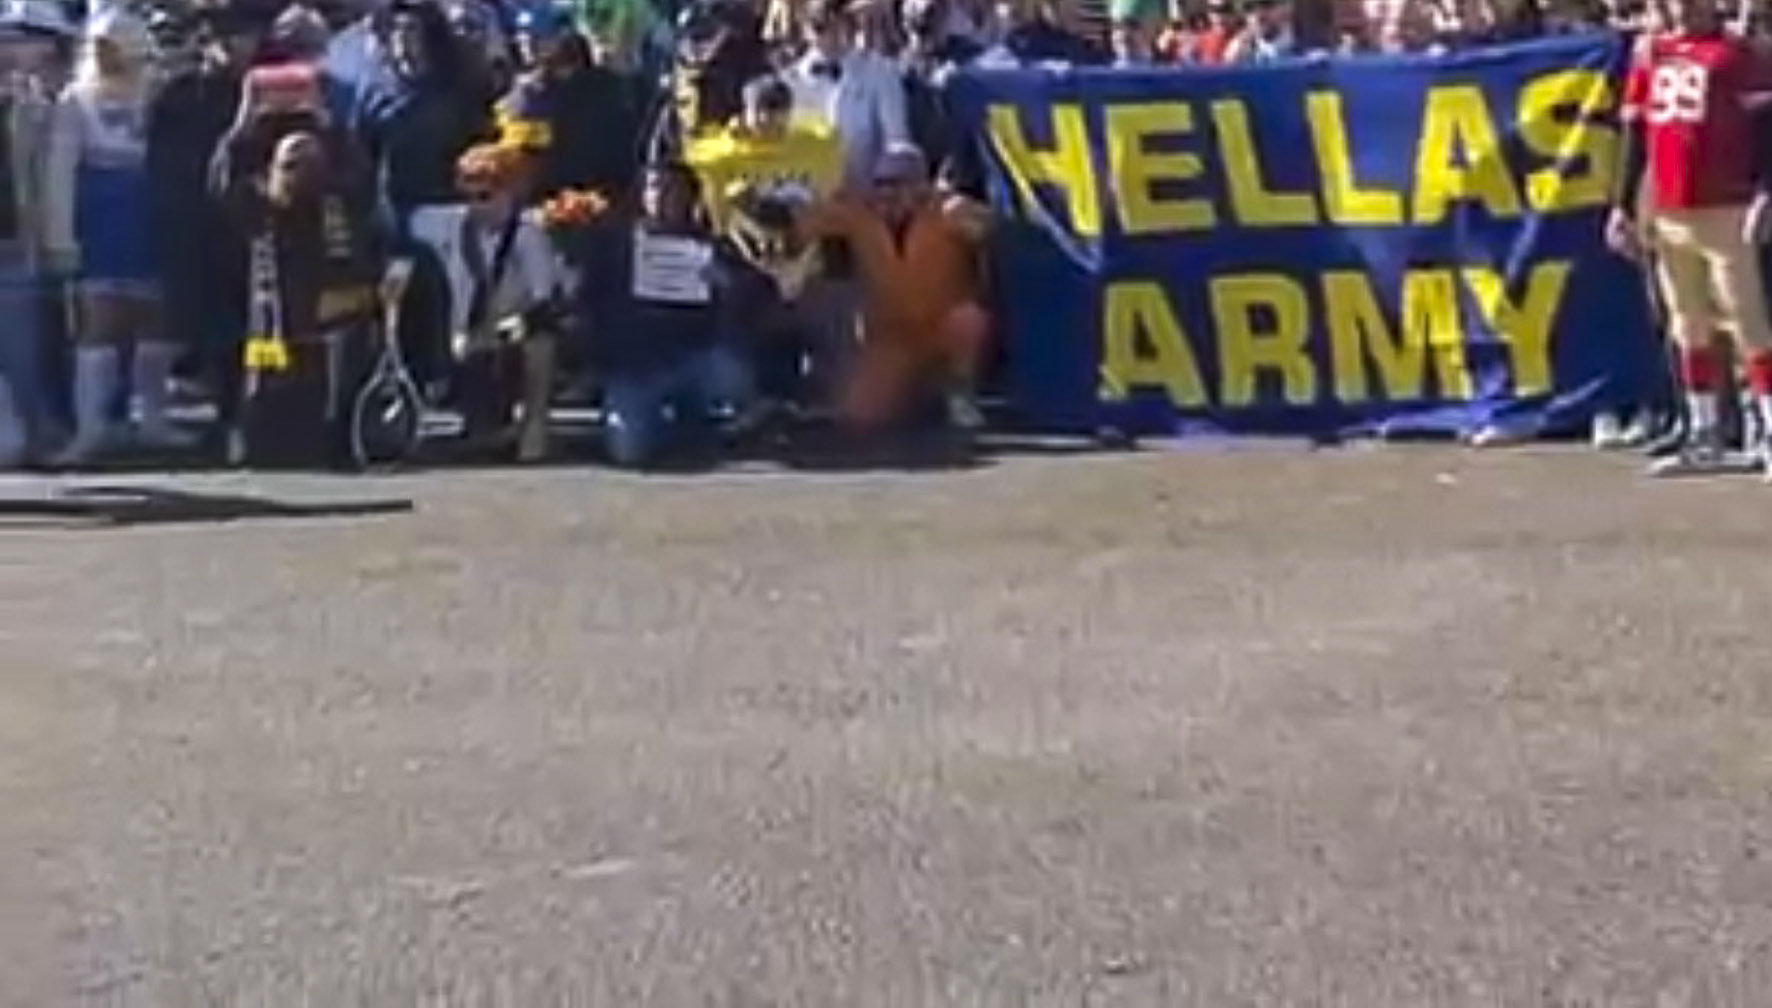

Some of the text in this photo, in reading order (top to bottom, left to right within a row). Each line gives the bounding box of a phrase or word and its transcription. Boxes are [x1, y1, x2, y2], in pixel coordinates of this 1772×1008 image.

[985, 68, 1620, 236] HELLAS
[1648, 64, 1708, 123] 99
[1098, 260, 1575, 408] ARMY
